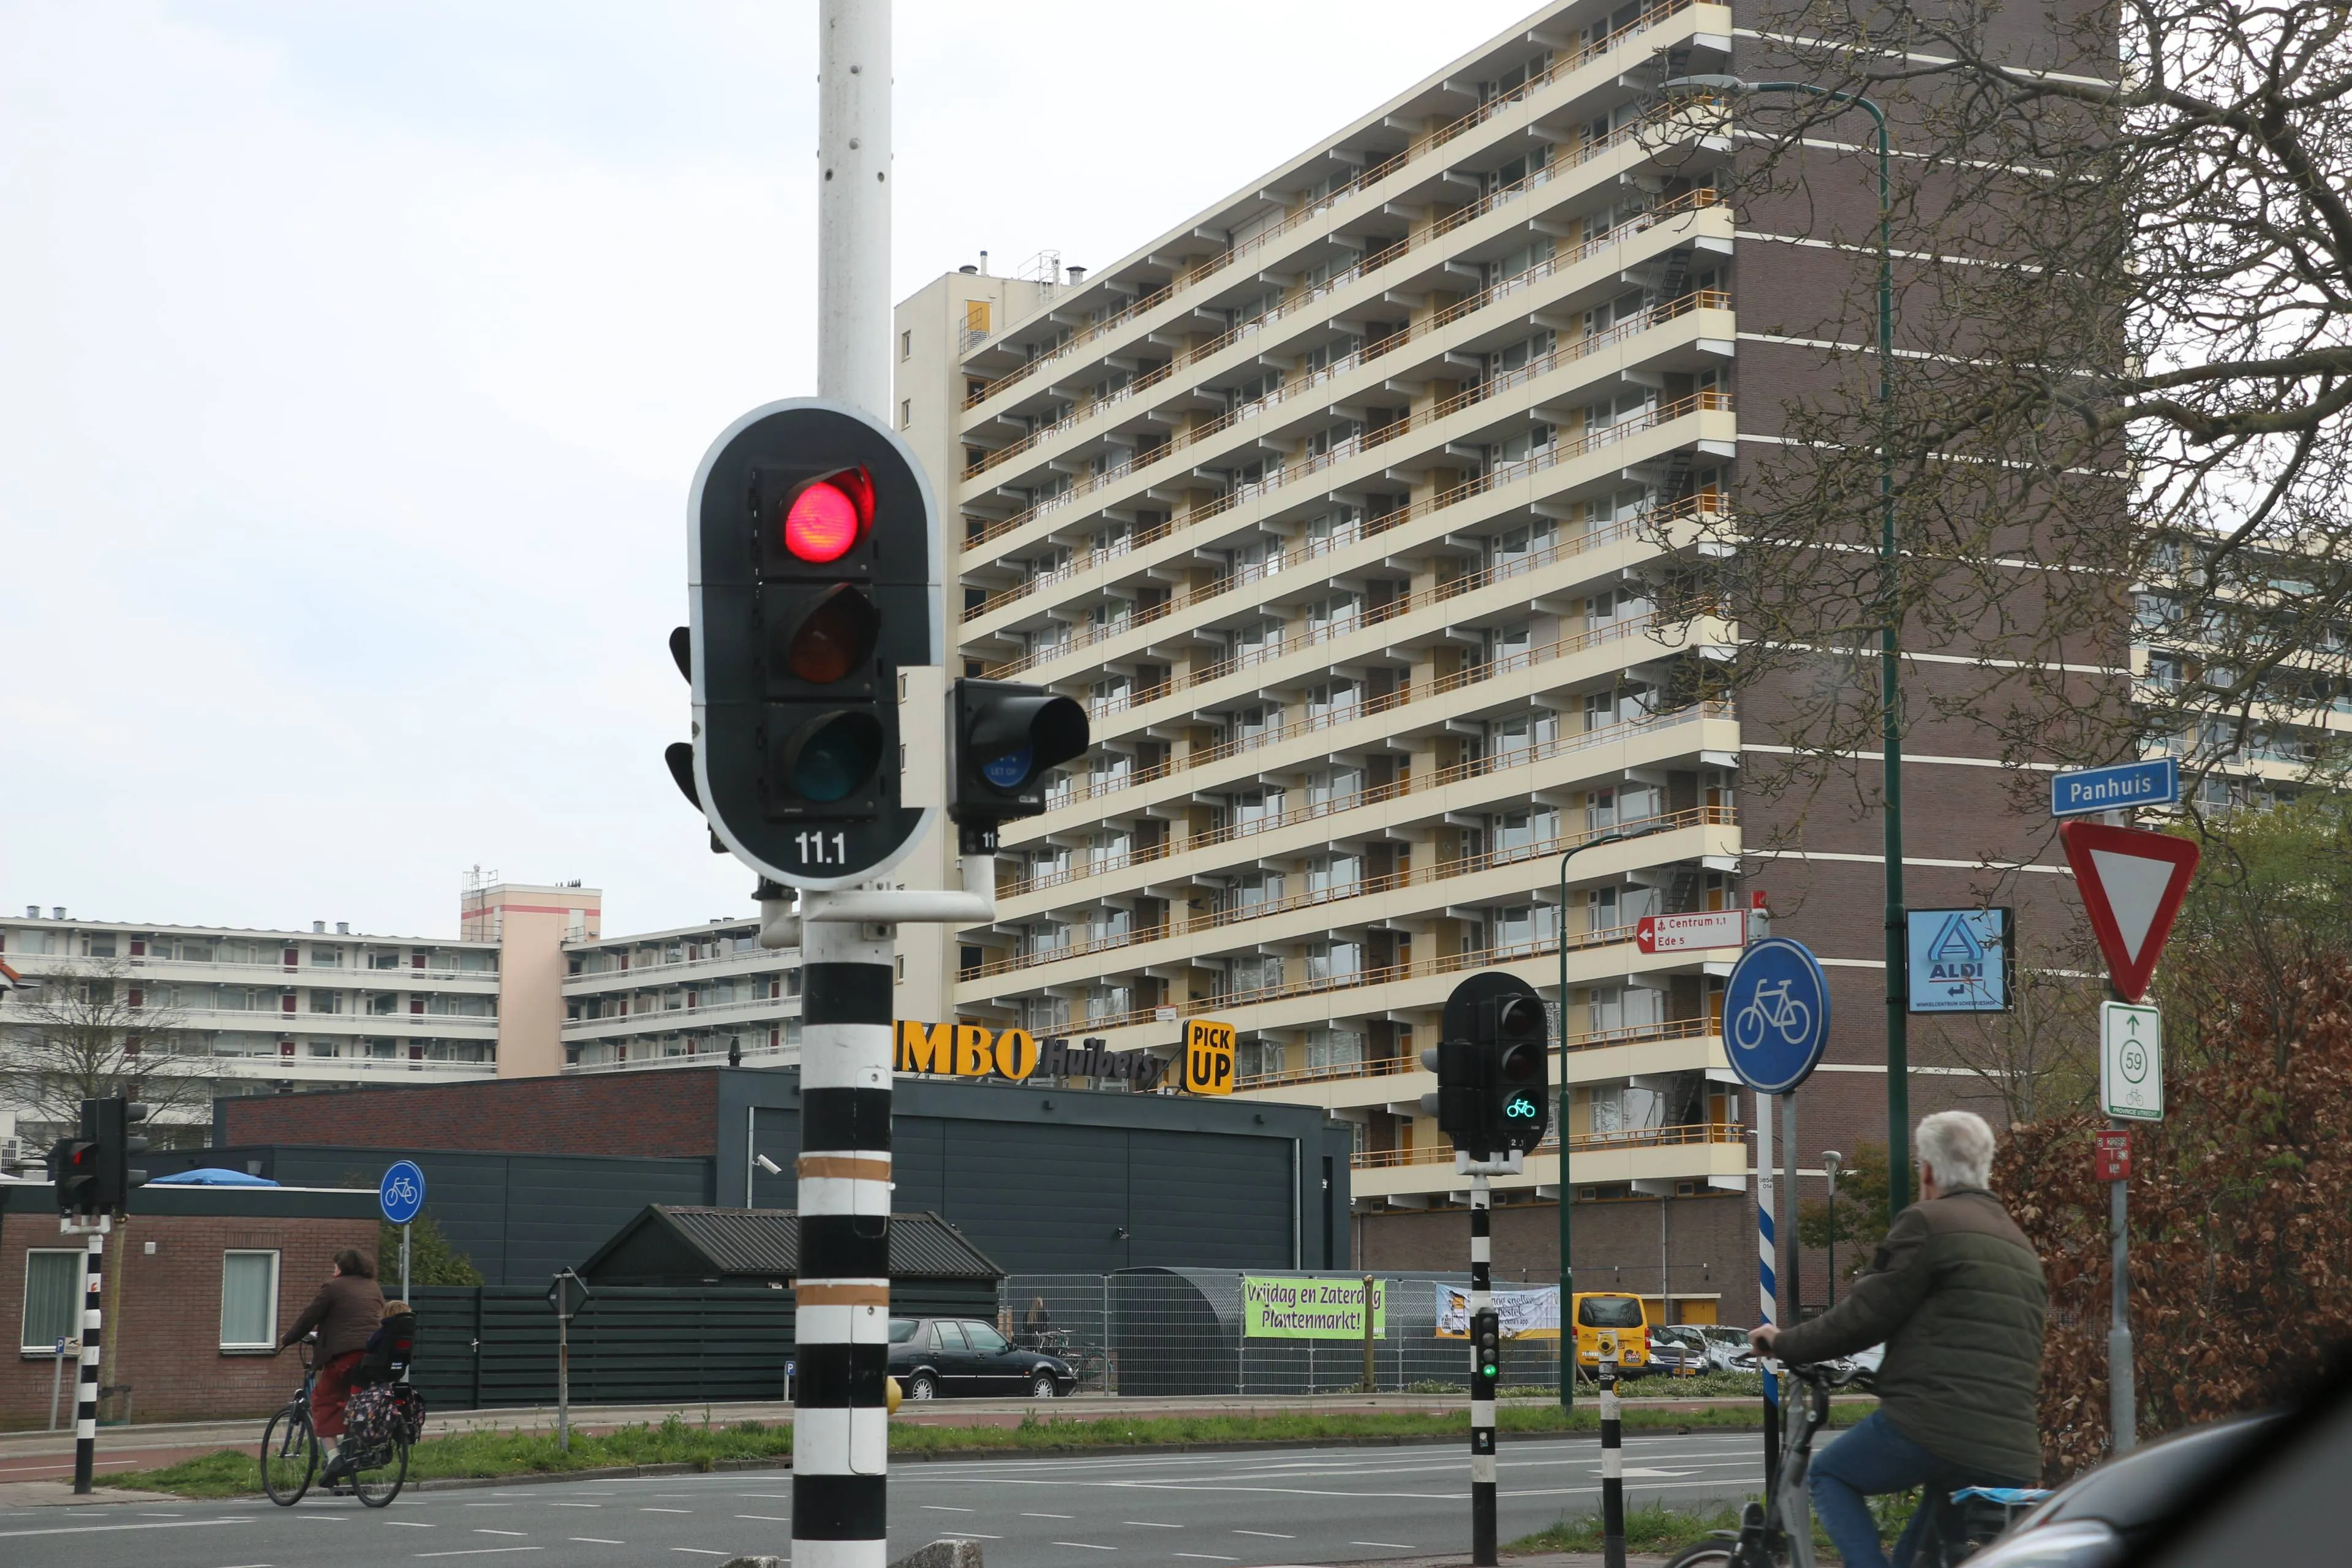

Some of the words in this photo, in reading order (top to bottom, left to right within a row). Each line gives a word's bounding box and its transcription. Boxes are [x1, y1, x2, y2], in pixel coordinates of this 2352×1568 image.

[991, 767, 1003, 775] LET
[2071, 774, 2151, 802] Panhuis
[795, 831, 845, 864] 11.1
[982, 832, 994, 848] 11
[1669, 918, 1713, 929] Centrum
[1716, 917, 1726, 925] 1.1
[1658, 937, 1676, 946] Ede
[1929, 963, 1983, 978] ALDI
[1194, 1026, 1231, 1049] PICK
[1041, 1038, 1154, 1080] Huibers
[1193, 1050, 1231, 1087] UP
[2126, 1052, 2142, 1070] 59
[1247, 1283, 1296, 1308] Vrijdag
[1300, 1288, 1316, 1303] en
[1320, 1286, 1382, 1310] Zaterdg
[1262, 1309, 1361, 1330] Plantenmarkt!
[788, 1363, 794, 1373] P
